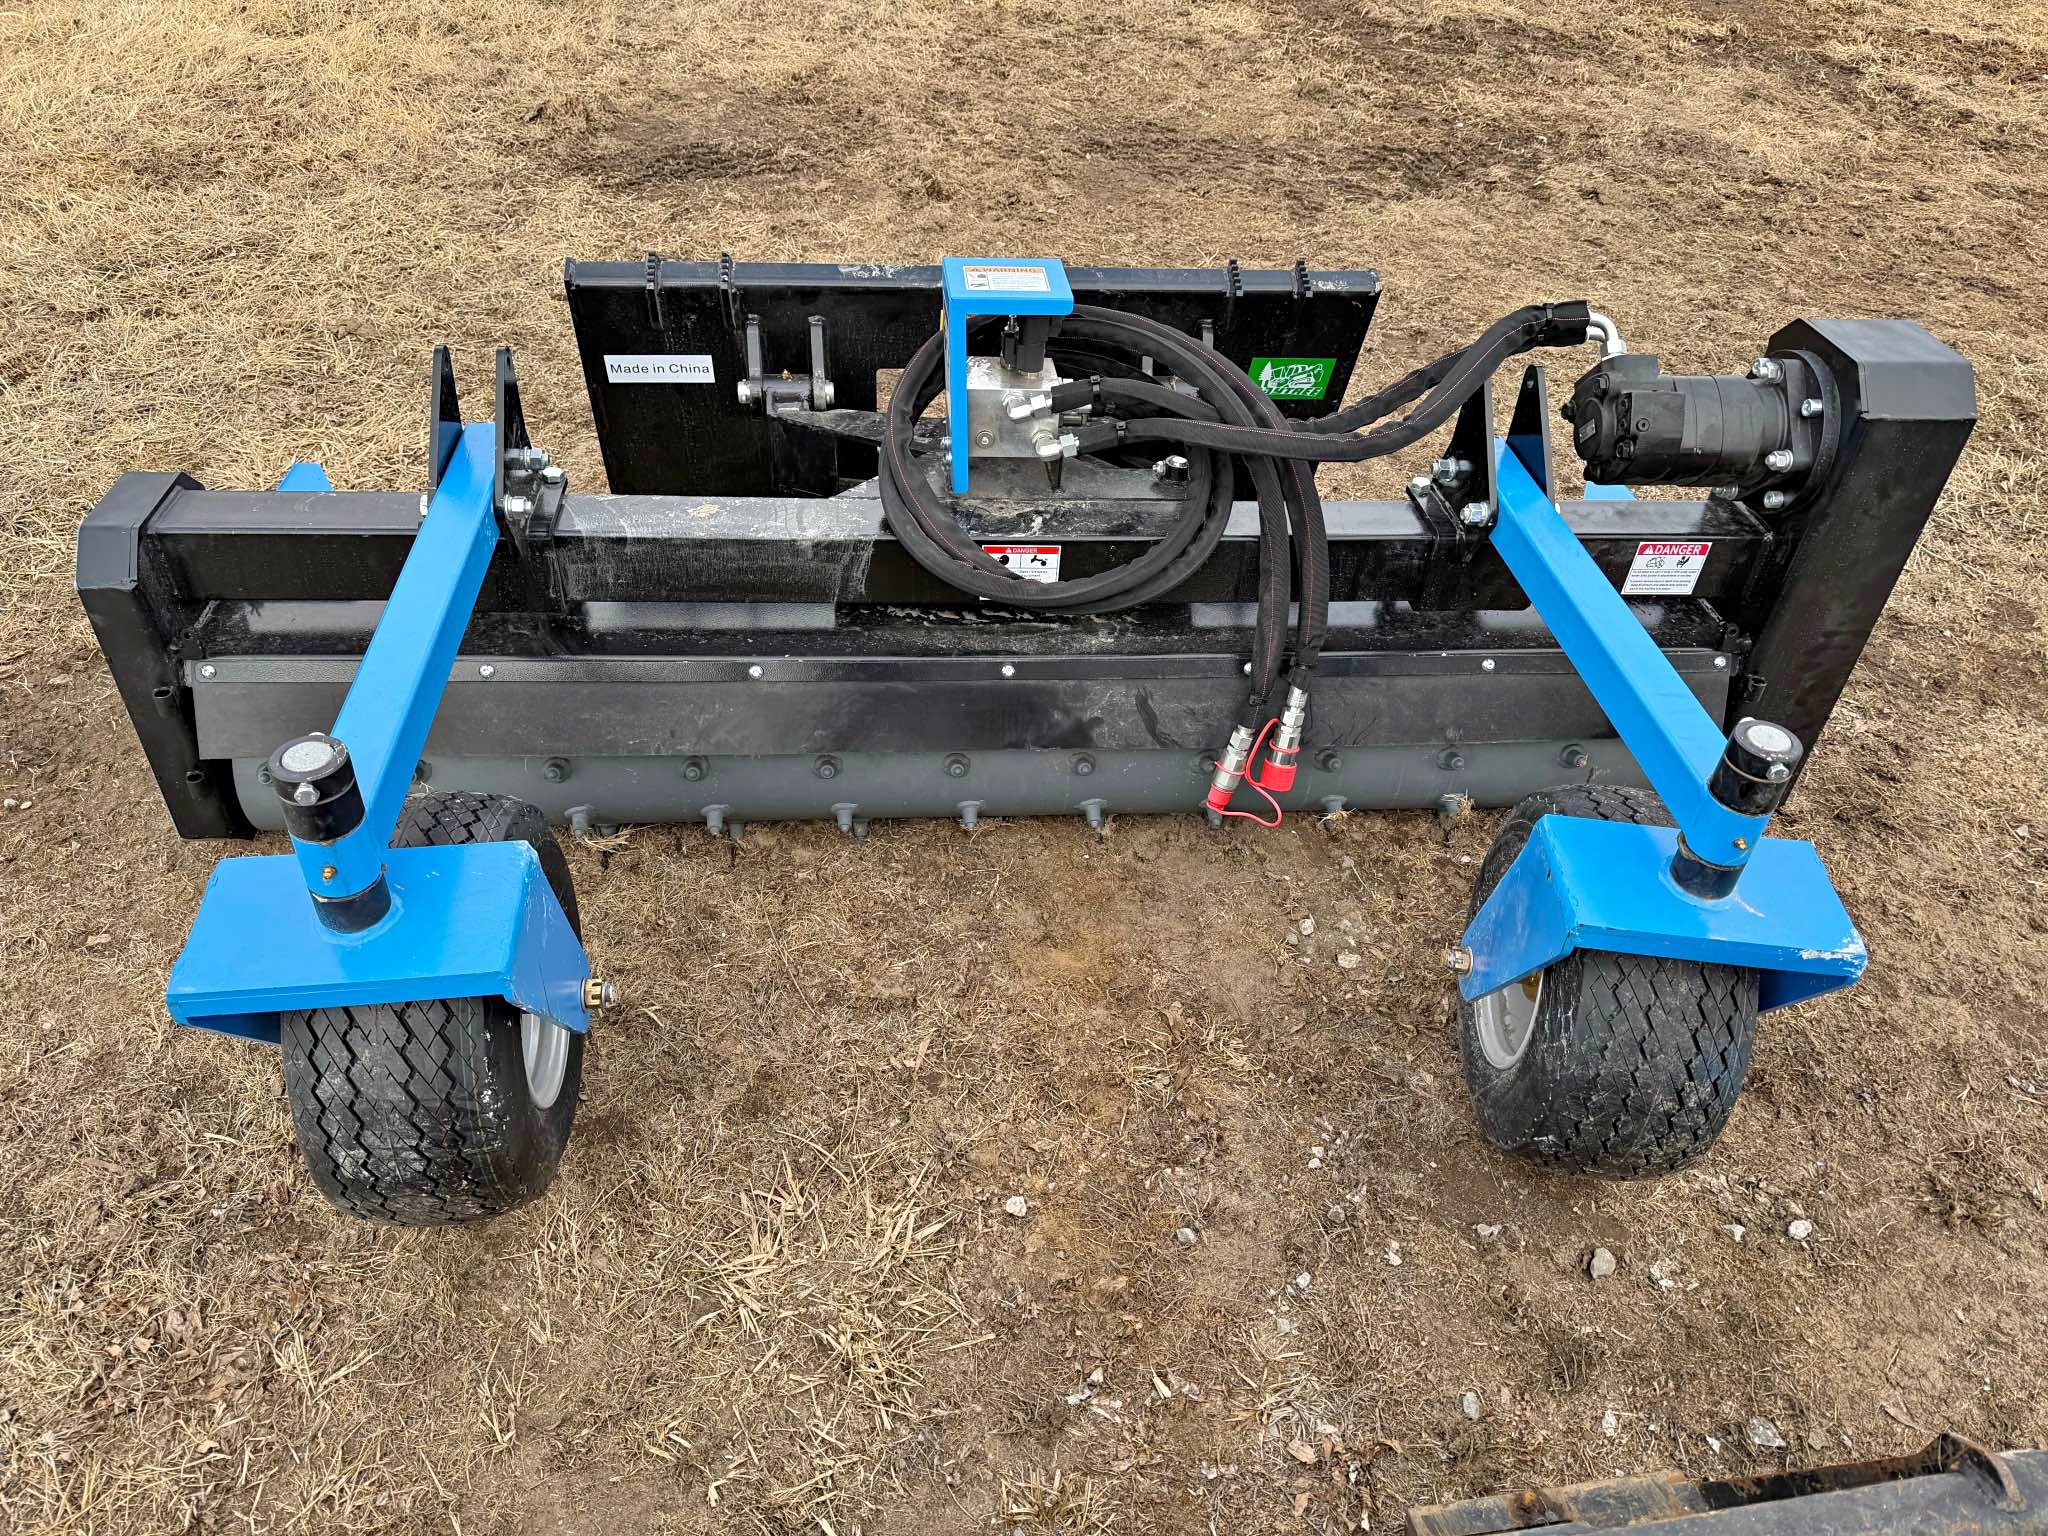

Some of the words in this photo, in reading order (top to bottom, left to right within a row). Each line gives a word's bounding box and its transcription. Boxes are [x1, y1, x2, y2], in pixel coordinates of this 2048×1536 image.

[610, 364, 649, 374] Made
[652, 363, 665, 374] in
[669, 363, 710, 374] China
[1654, 544, 1702, 555] DANGER
